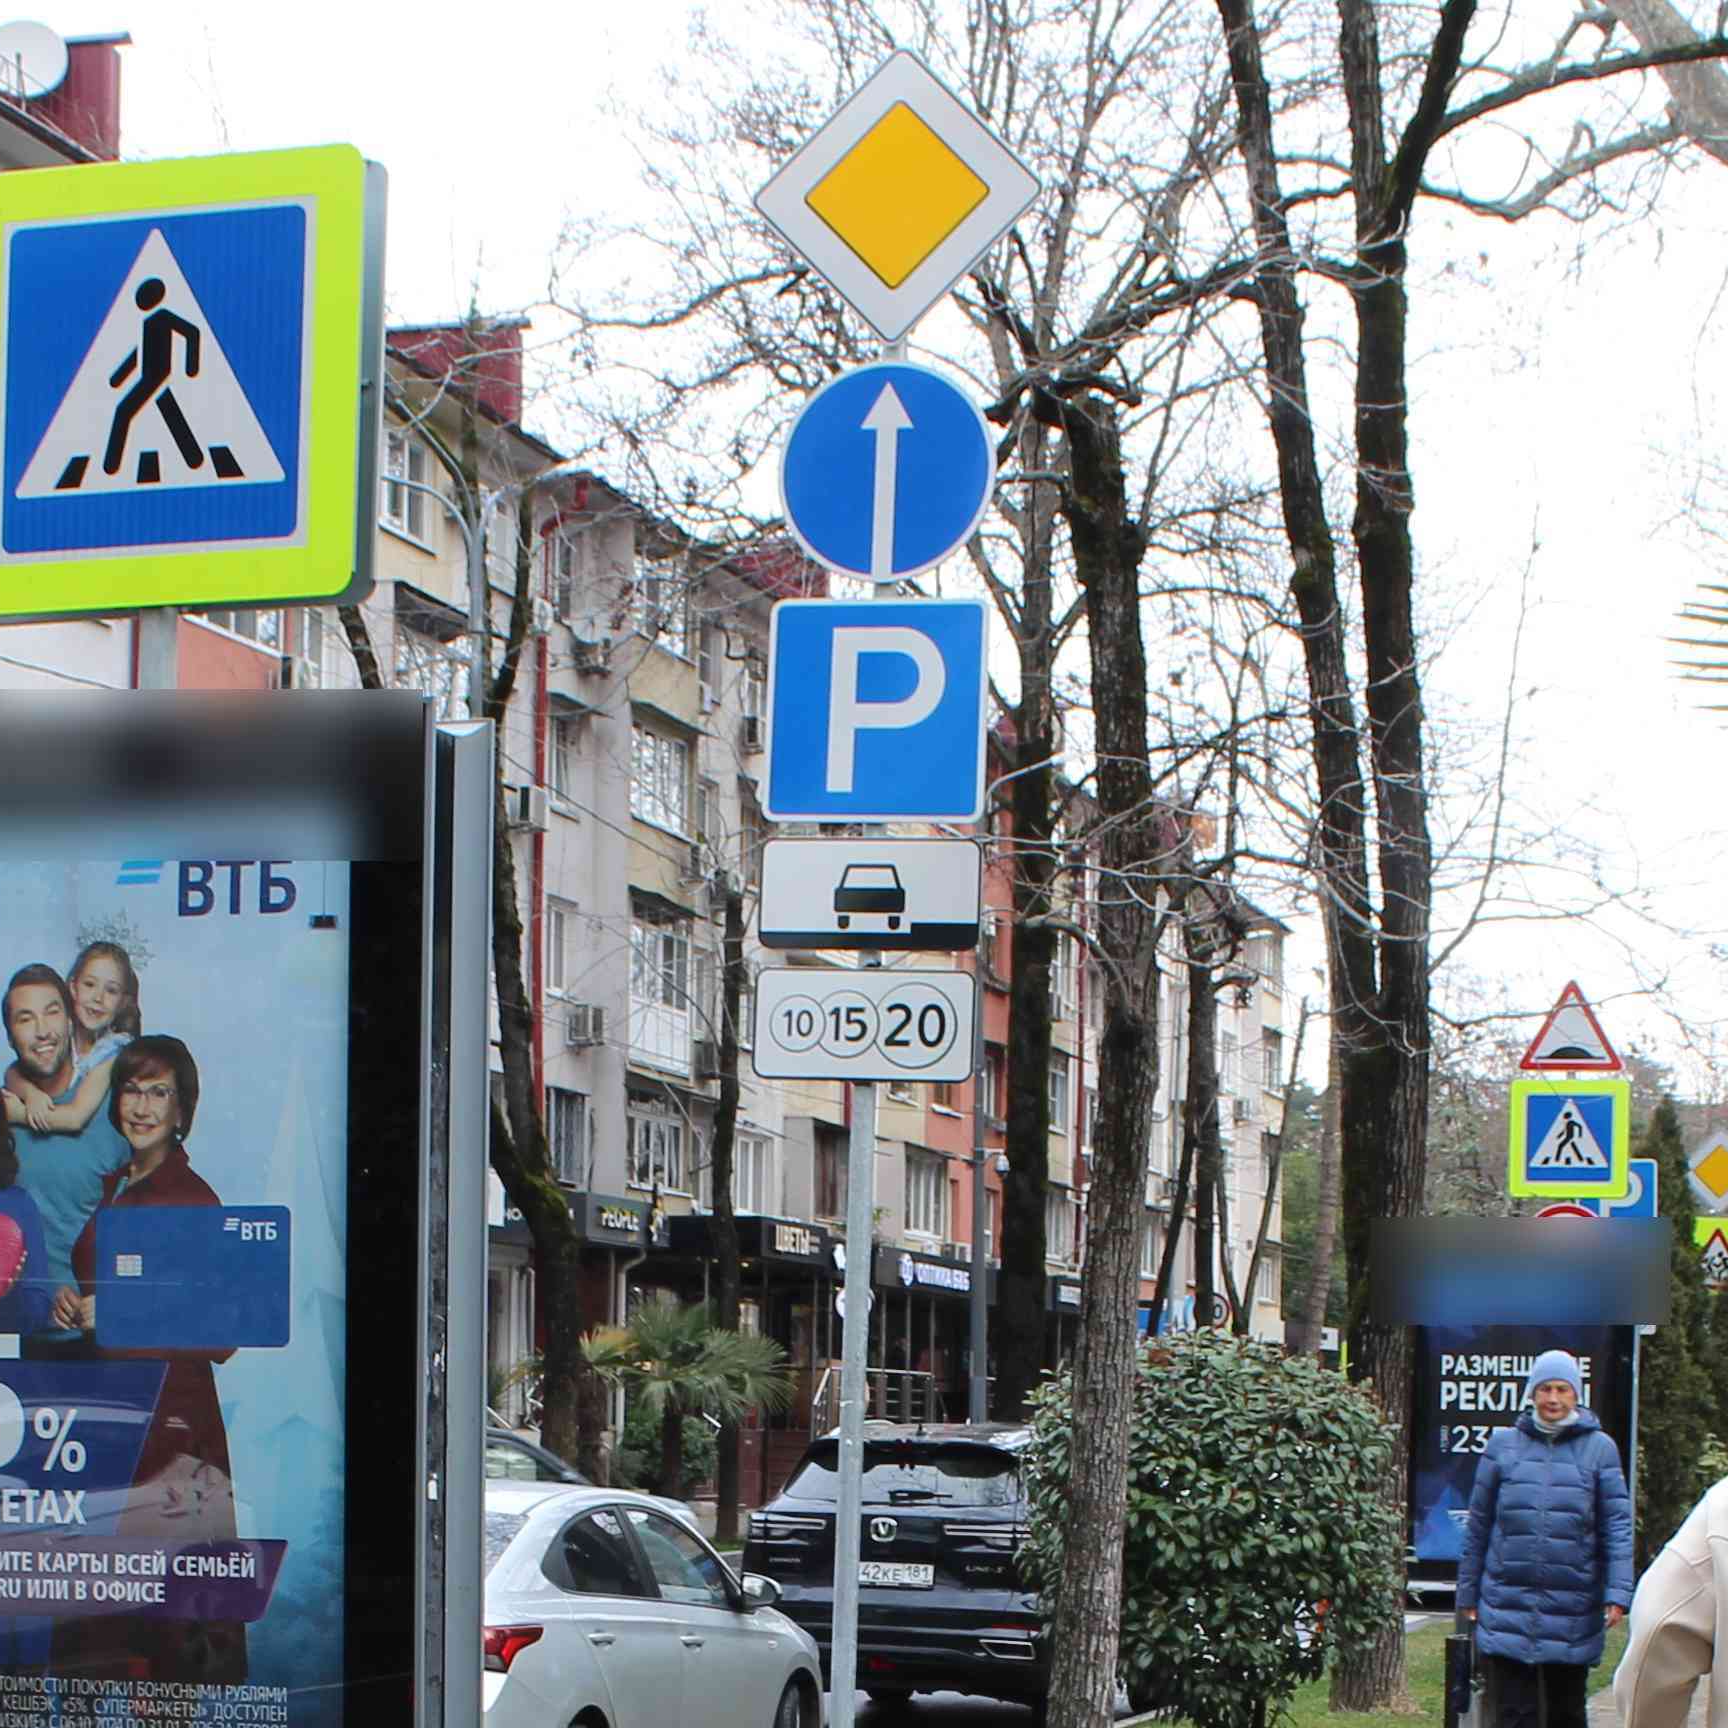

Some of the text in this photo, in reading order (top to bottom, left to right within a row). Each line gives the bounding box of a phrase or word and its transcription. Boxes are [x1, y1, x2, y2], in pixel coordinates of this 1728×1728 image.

[825, 625, 947, 794] P
[179, 861, 297, 917] ВТБ
[783, 1002, 946, 1048] 10 15 20
[241, 1222, 277, 1241] ВТБ
[775, 1224, 810, 1256] ЦВЕТЫ
[38, 1552, 108, 1574] КАРТЫ
[114, 1550, 166, 1576] ВСЕЙ
[172, 1552, 256, 1578] СЕМЬЁЙ
[861, 1564, 929, 1581] 42КЕ 181
[27, 1579, 69, 1600] ИЛИ
[75, 1580, 87, 1600] В
[92, 1580, 166, 1603] ОФИСЕ
[71, 1679, 132, 1696] ПОКУПКИ
[136, 1681, 221, 1700] БОНУСНЫМИ
[224, 1685, 287, 1702] РУБЛЯМИ
[2, 1694, 56, 1711] КЕШБЭК
[92, 1698, 207, 1717] СУПЕРМАРКЕТЫ»
[212, 1703, 287, 1721] ДОСТУПЕН
